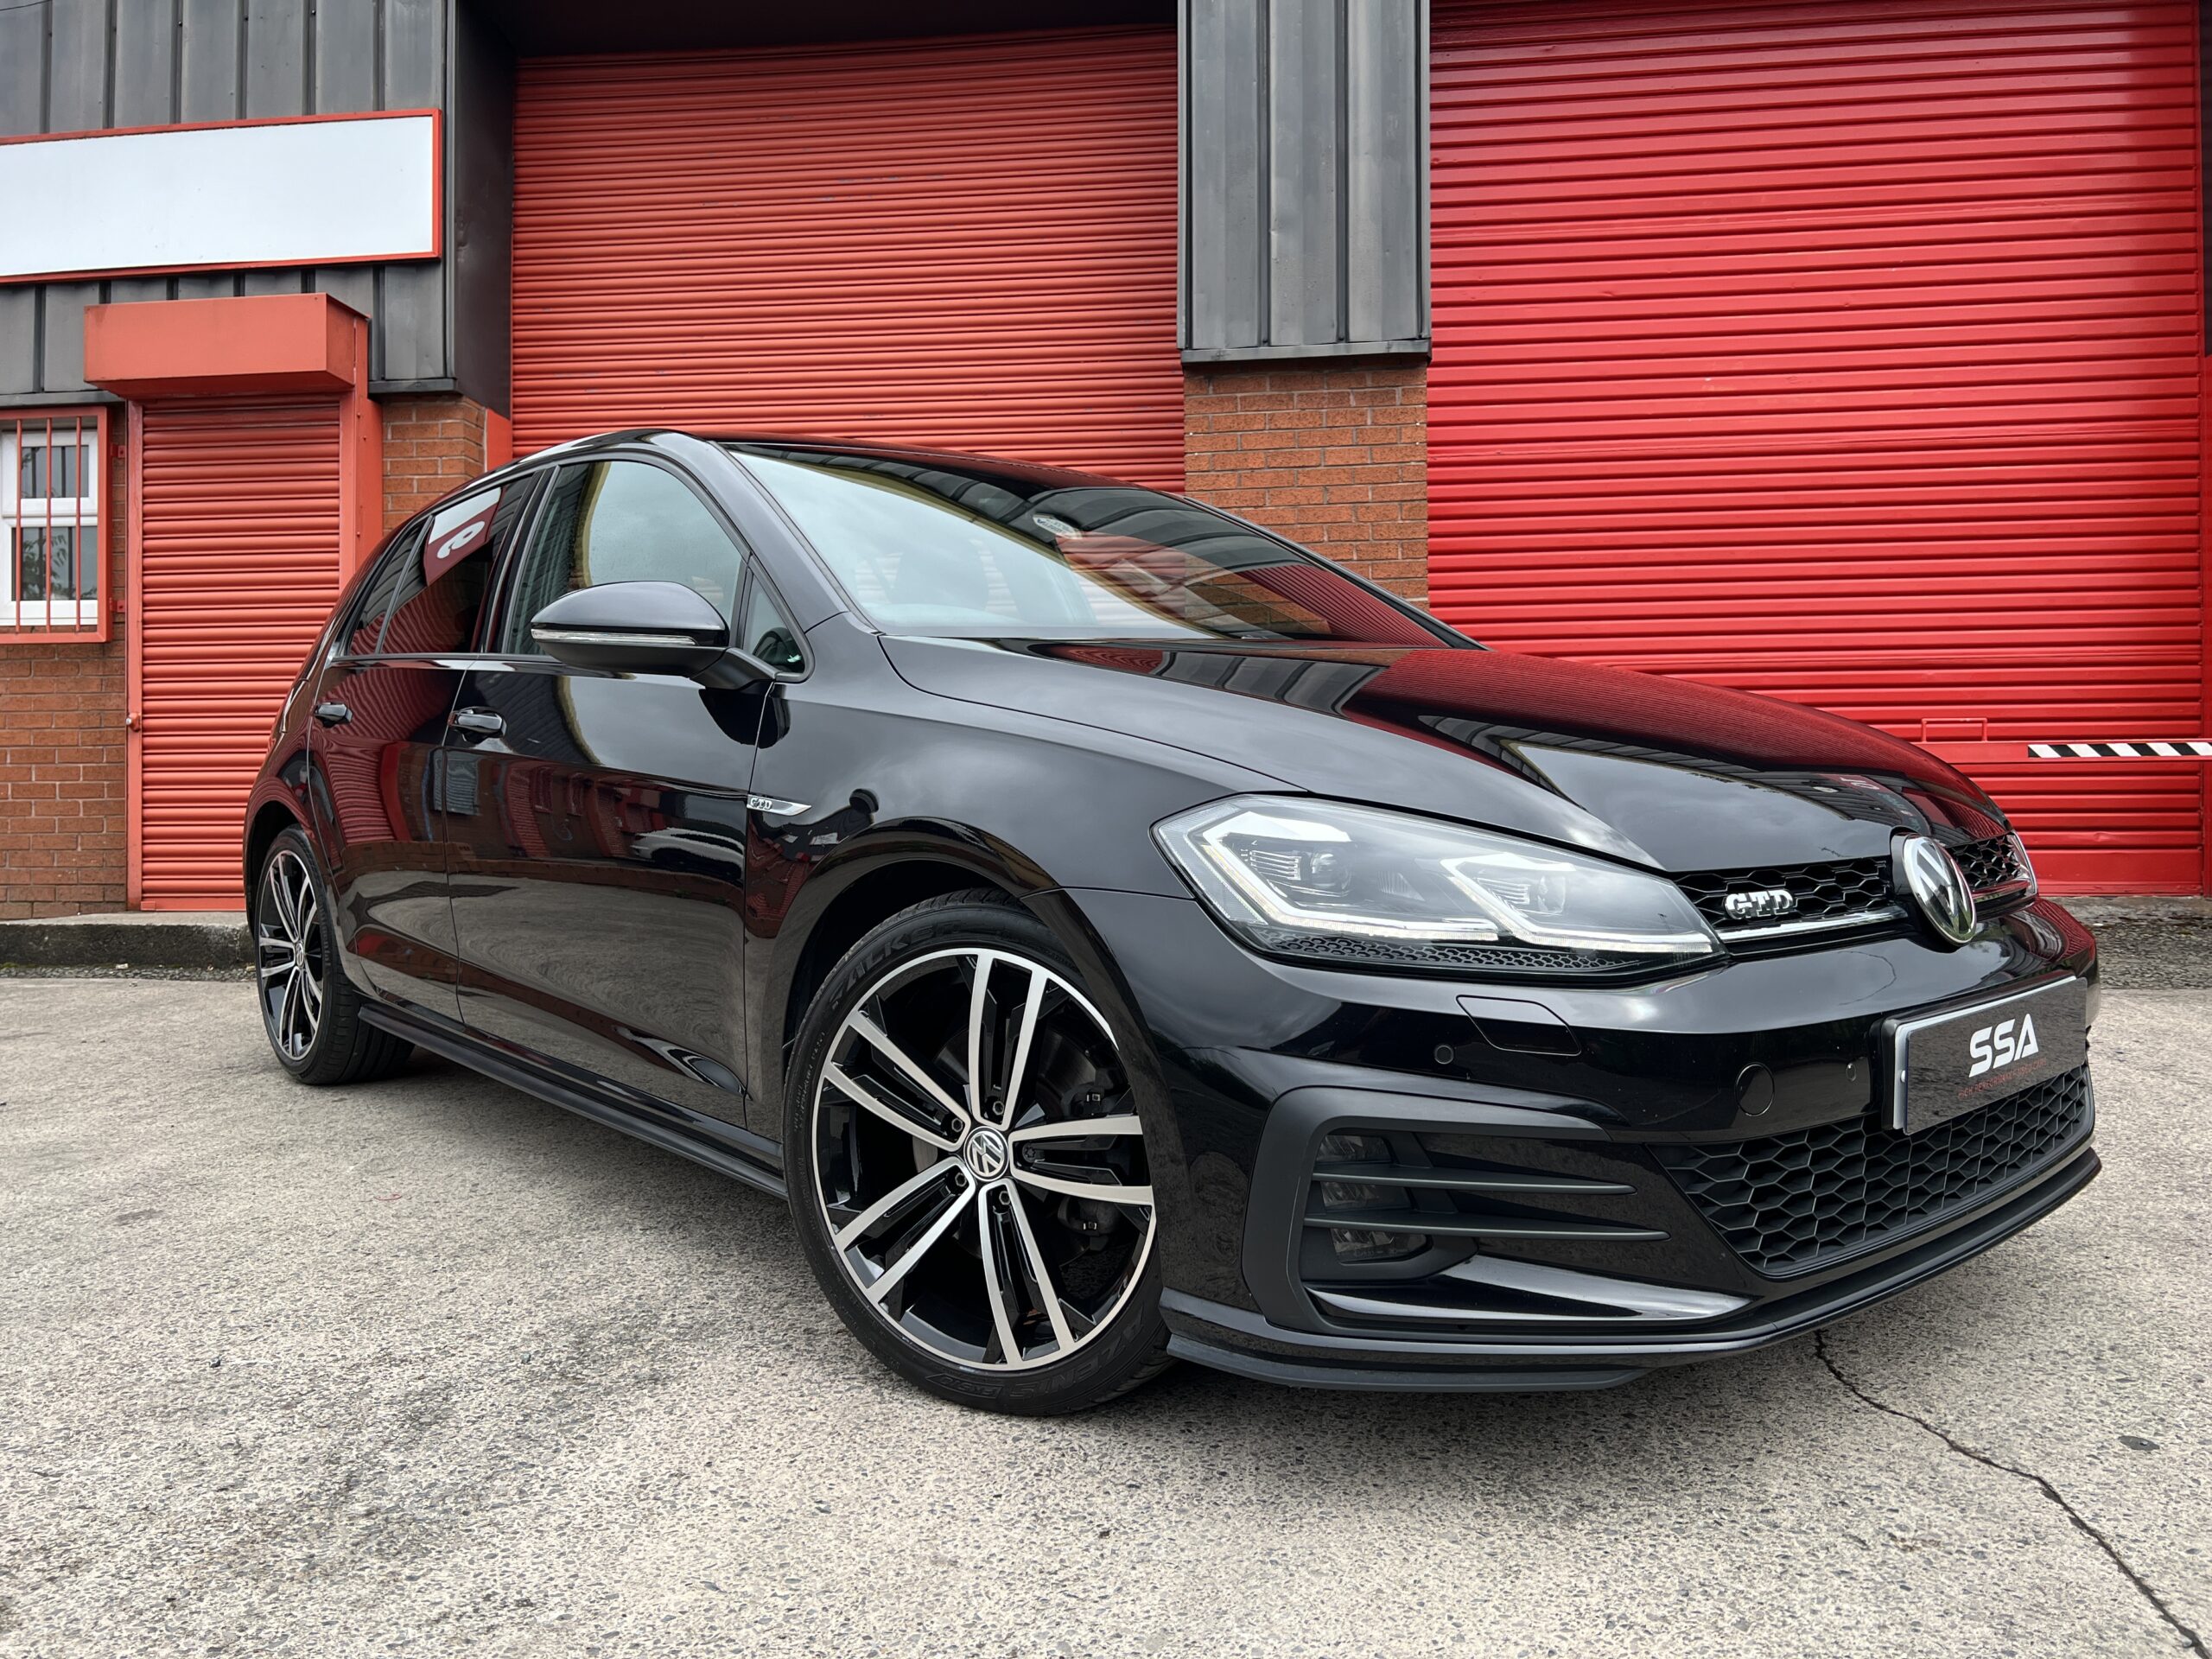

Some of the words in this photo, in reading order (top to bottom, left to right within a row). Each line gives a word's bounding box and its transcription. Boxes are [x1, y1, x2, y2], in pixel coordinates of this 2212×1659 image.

[750, 797, 772, 810] GTD
[1725, 889, 1793, 920] GTD
[1968, 1013, 2039, 1077] SSA
